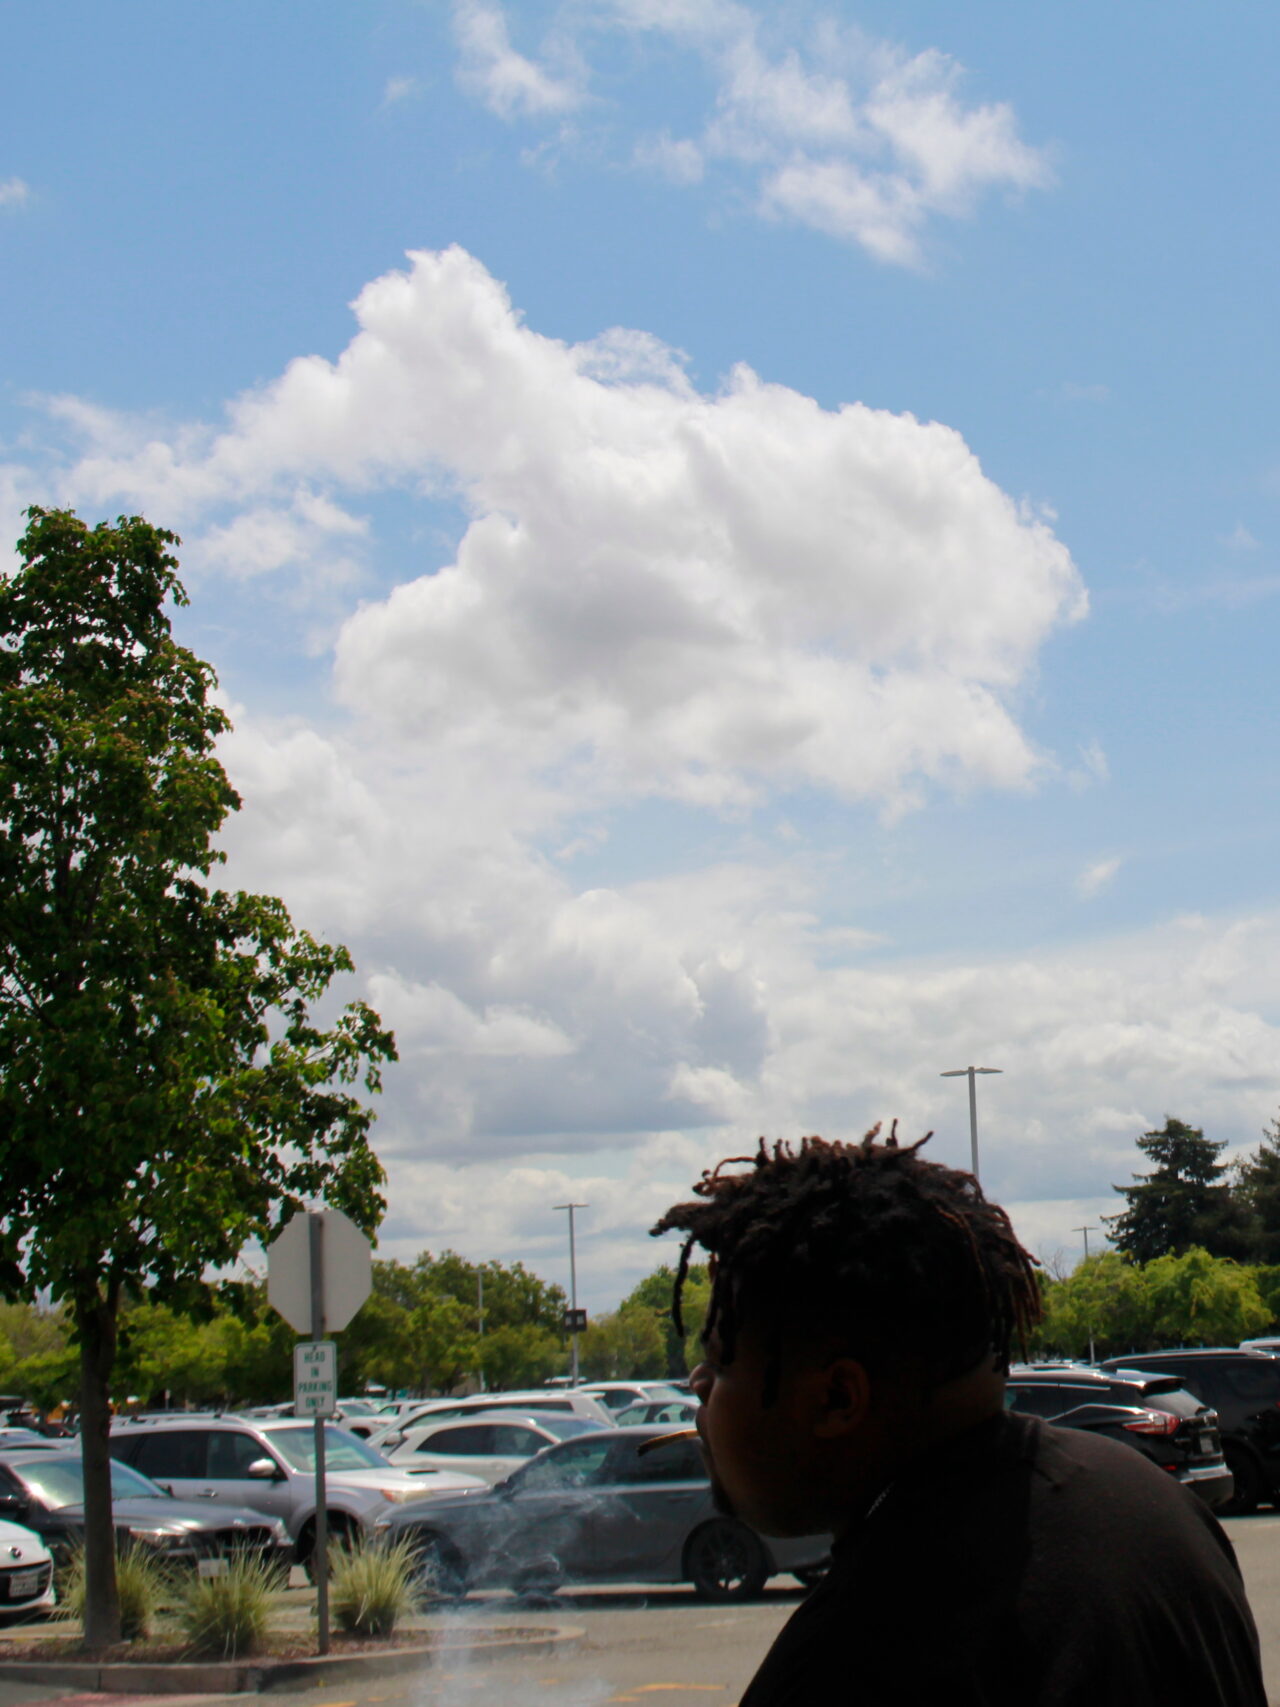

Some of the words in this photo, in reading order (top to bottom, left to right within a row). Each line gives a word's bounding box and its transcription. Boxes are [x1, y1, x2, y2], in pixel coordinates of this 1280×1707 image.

[303, 1351, 326, 1364] HEAD
[310, 1367, 320, 1378] IN
[298, 1380, 333, 1393] PARKING
[305, 1396, 325, 1409] ONLY
